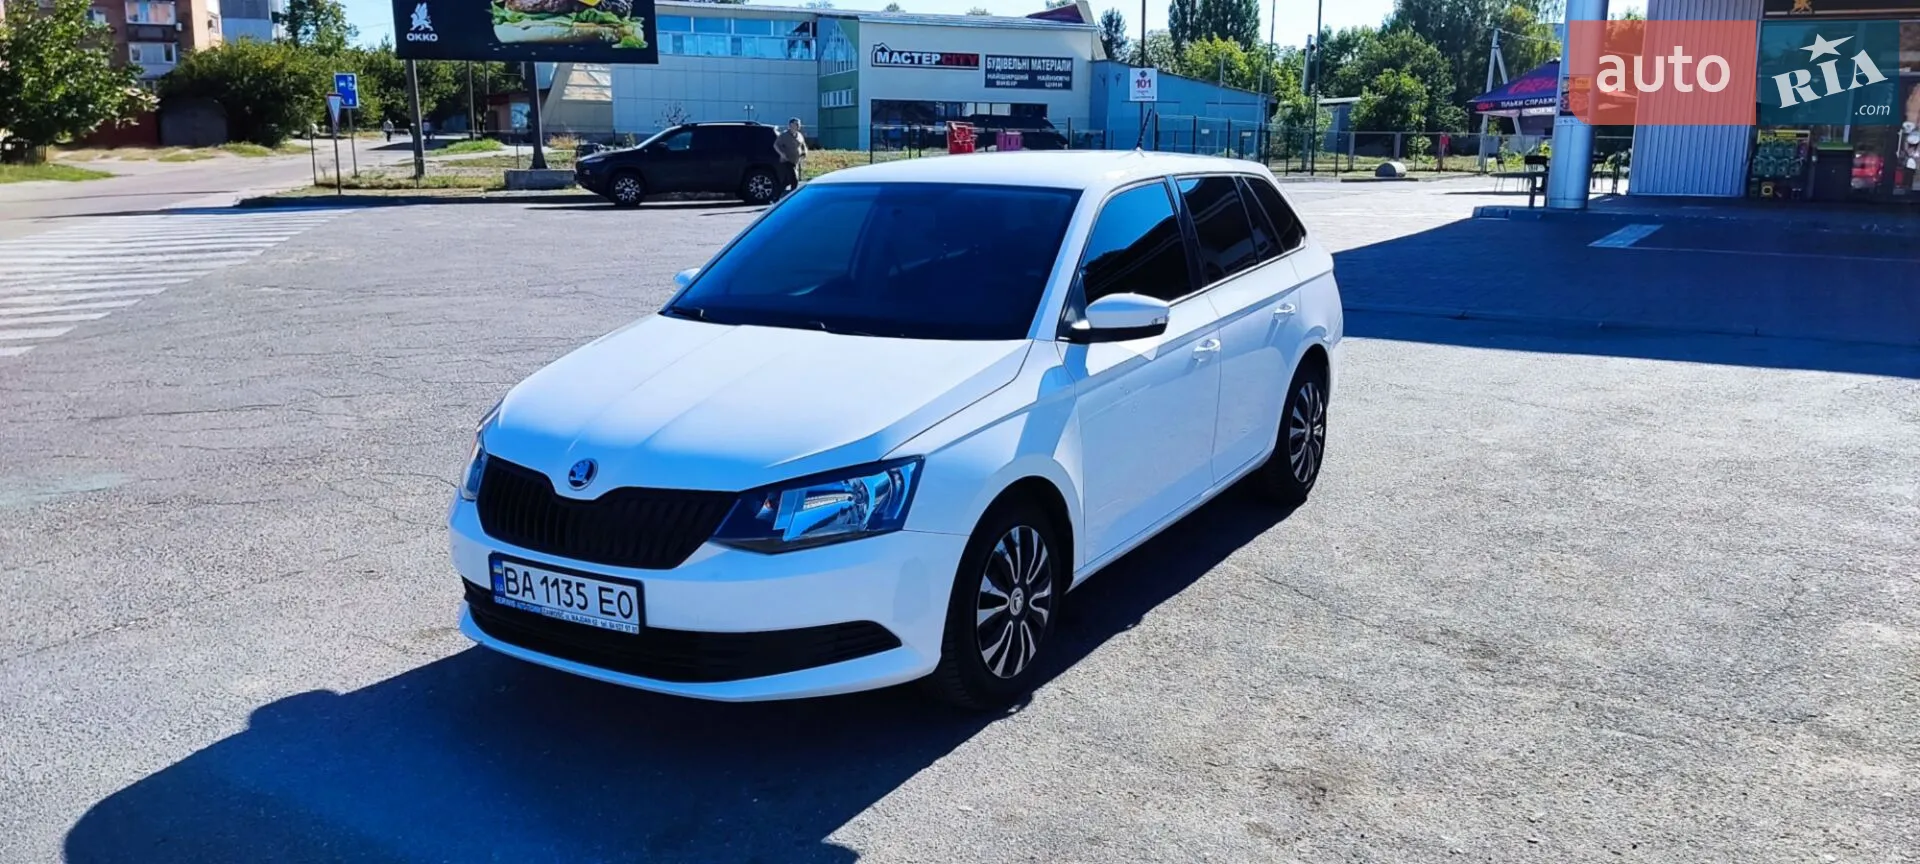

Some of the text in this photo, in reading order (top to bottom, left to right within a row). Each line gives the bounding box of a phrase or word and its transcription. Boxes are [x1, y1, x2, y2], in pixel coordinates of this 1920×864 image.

[406, 33, 438, 42] OKKO
[987, 57, 1071, 71] БУДІВЕЛЬНІ МАТЕРІАЛИ
[1135, 78, 1152, 89] 101
[504, 566, 633, 619] BA 1135 EO
